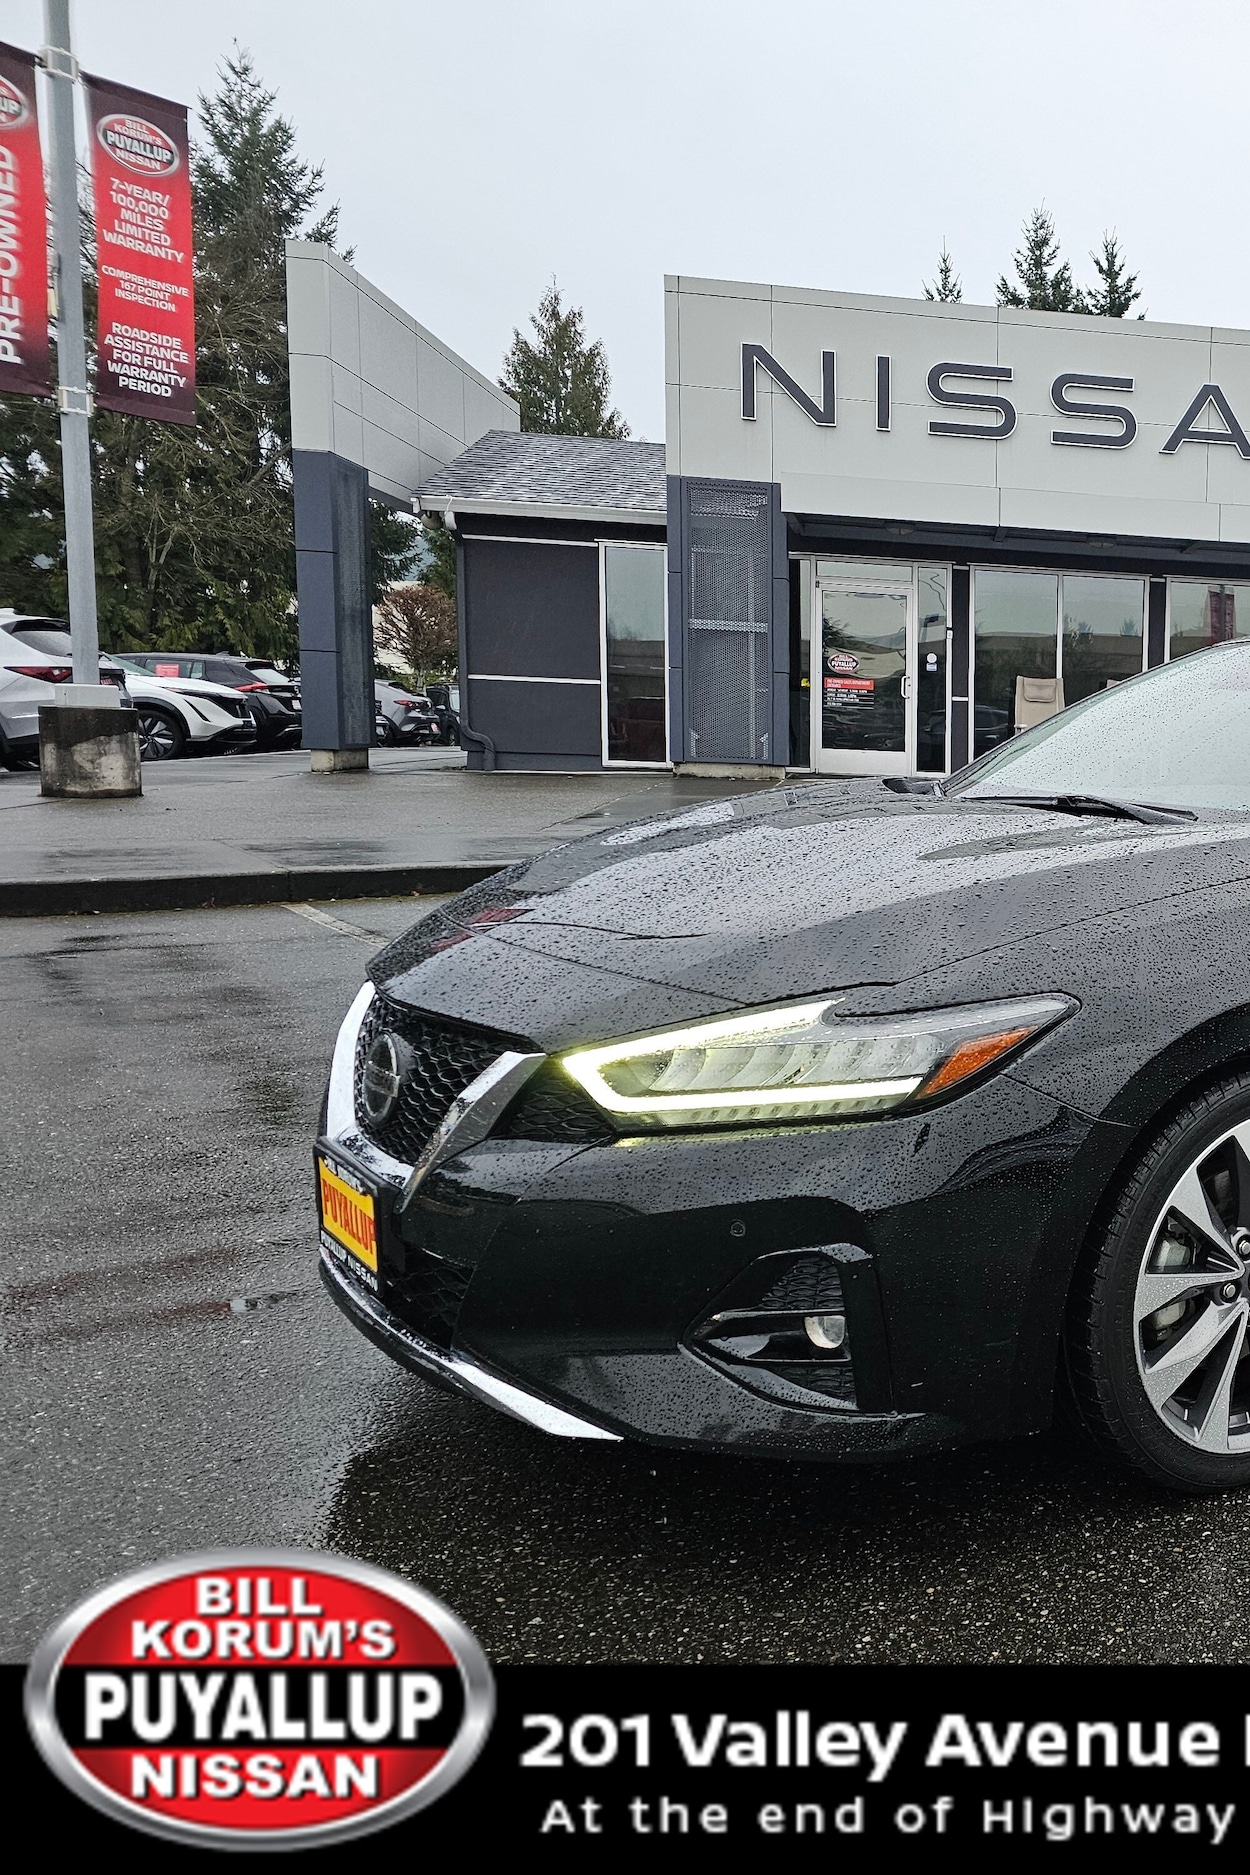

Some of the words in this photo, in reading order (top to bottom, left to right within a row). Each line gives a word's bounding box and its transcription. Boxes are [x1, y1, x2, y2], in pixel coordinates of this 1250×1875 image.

[113, 123, 163, 146] KORUM'S
[125, 119, 151, 134] BILL
[106, 130, 174, 162] PUYALLUP
[115, 149, 161, 171] NISSAN
[110, 177, 171, 206] 7-YEAR/
[110, 190, 169, 219] 100,000
[114, 219, 172, 246] LIMITED
[120, 208, 165, 231] MILES
[0, 145, 24, 365] PRE-OWNED
[102, 229, 185, 263] WARRANTY
[101, 264, 190, 297] COMPREHENSIVE
[120, 279, 136, 292] 167
[138, 285, 171, 301] POINT
[114, 287, 176, 312] INSPECTION
[104, 334, 190, 364] ASSISTANCE
[111, 321, 183, 350] ROADSIDE
[107, 360, 187, 388] WARRANTY
[112, 348, 142, 366] FOR
[143, 356, 178, 374] FULL
[118, 375, 172, 397] PERIOD
[321, 1177, 376, 1255] PUYALLUP
[347, 1254, 379, 1292] NISSAN
